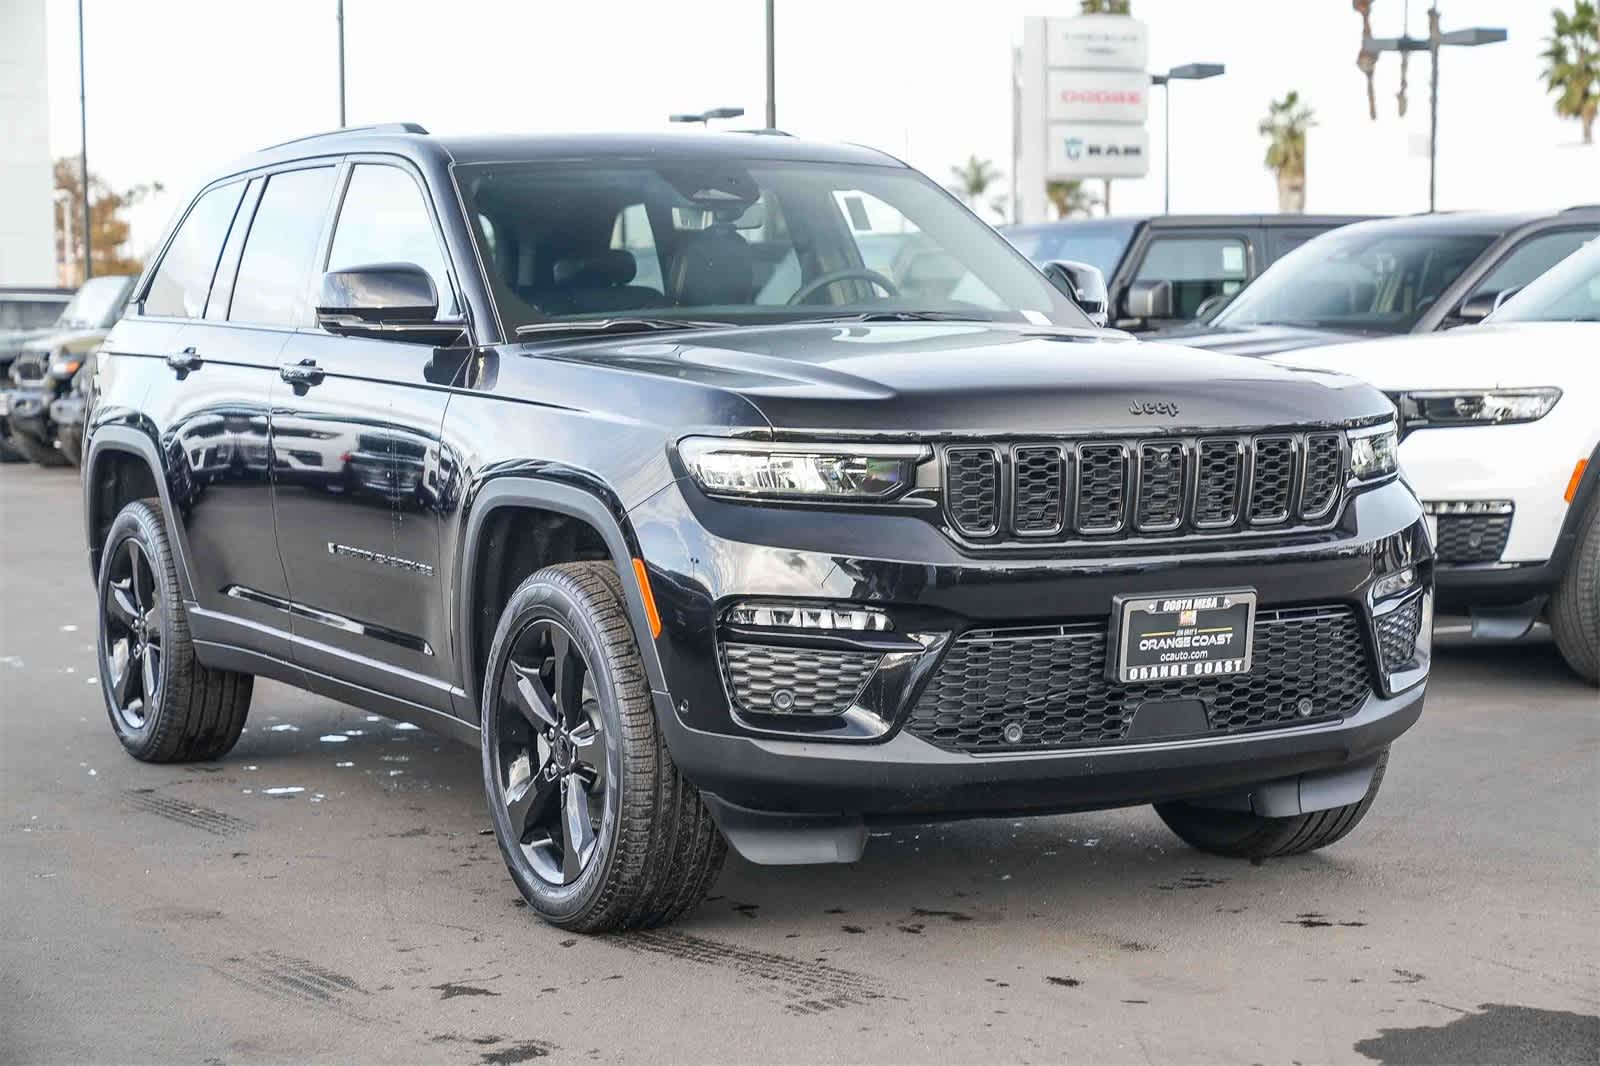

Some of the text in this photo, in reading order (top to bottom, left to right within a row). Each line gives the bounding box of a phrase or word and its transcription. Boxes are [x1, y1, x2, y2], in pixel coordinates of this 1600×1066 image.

[1129, 399, 1179, 417] Jeep
[1194, 597, 1218, 610] MESA
[1139, 633, 1233, 651] ORANGE COAST
[1160, 649, 1208, 662] ocauto.com
[1129, 660, 1243, 680] ORANGE COAST
